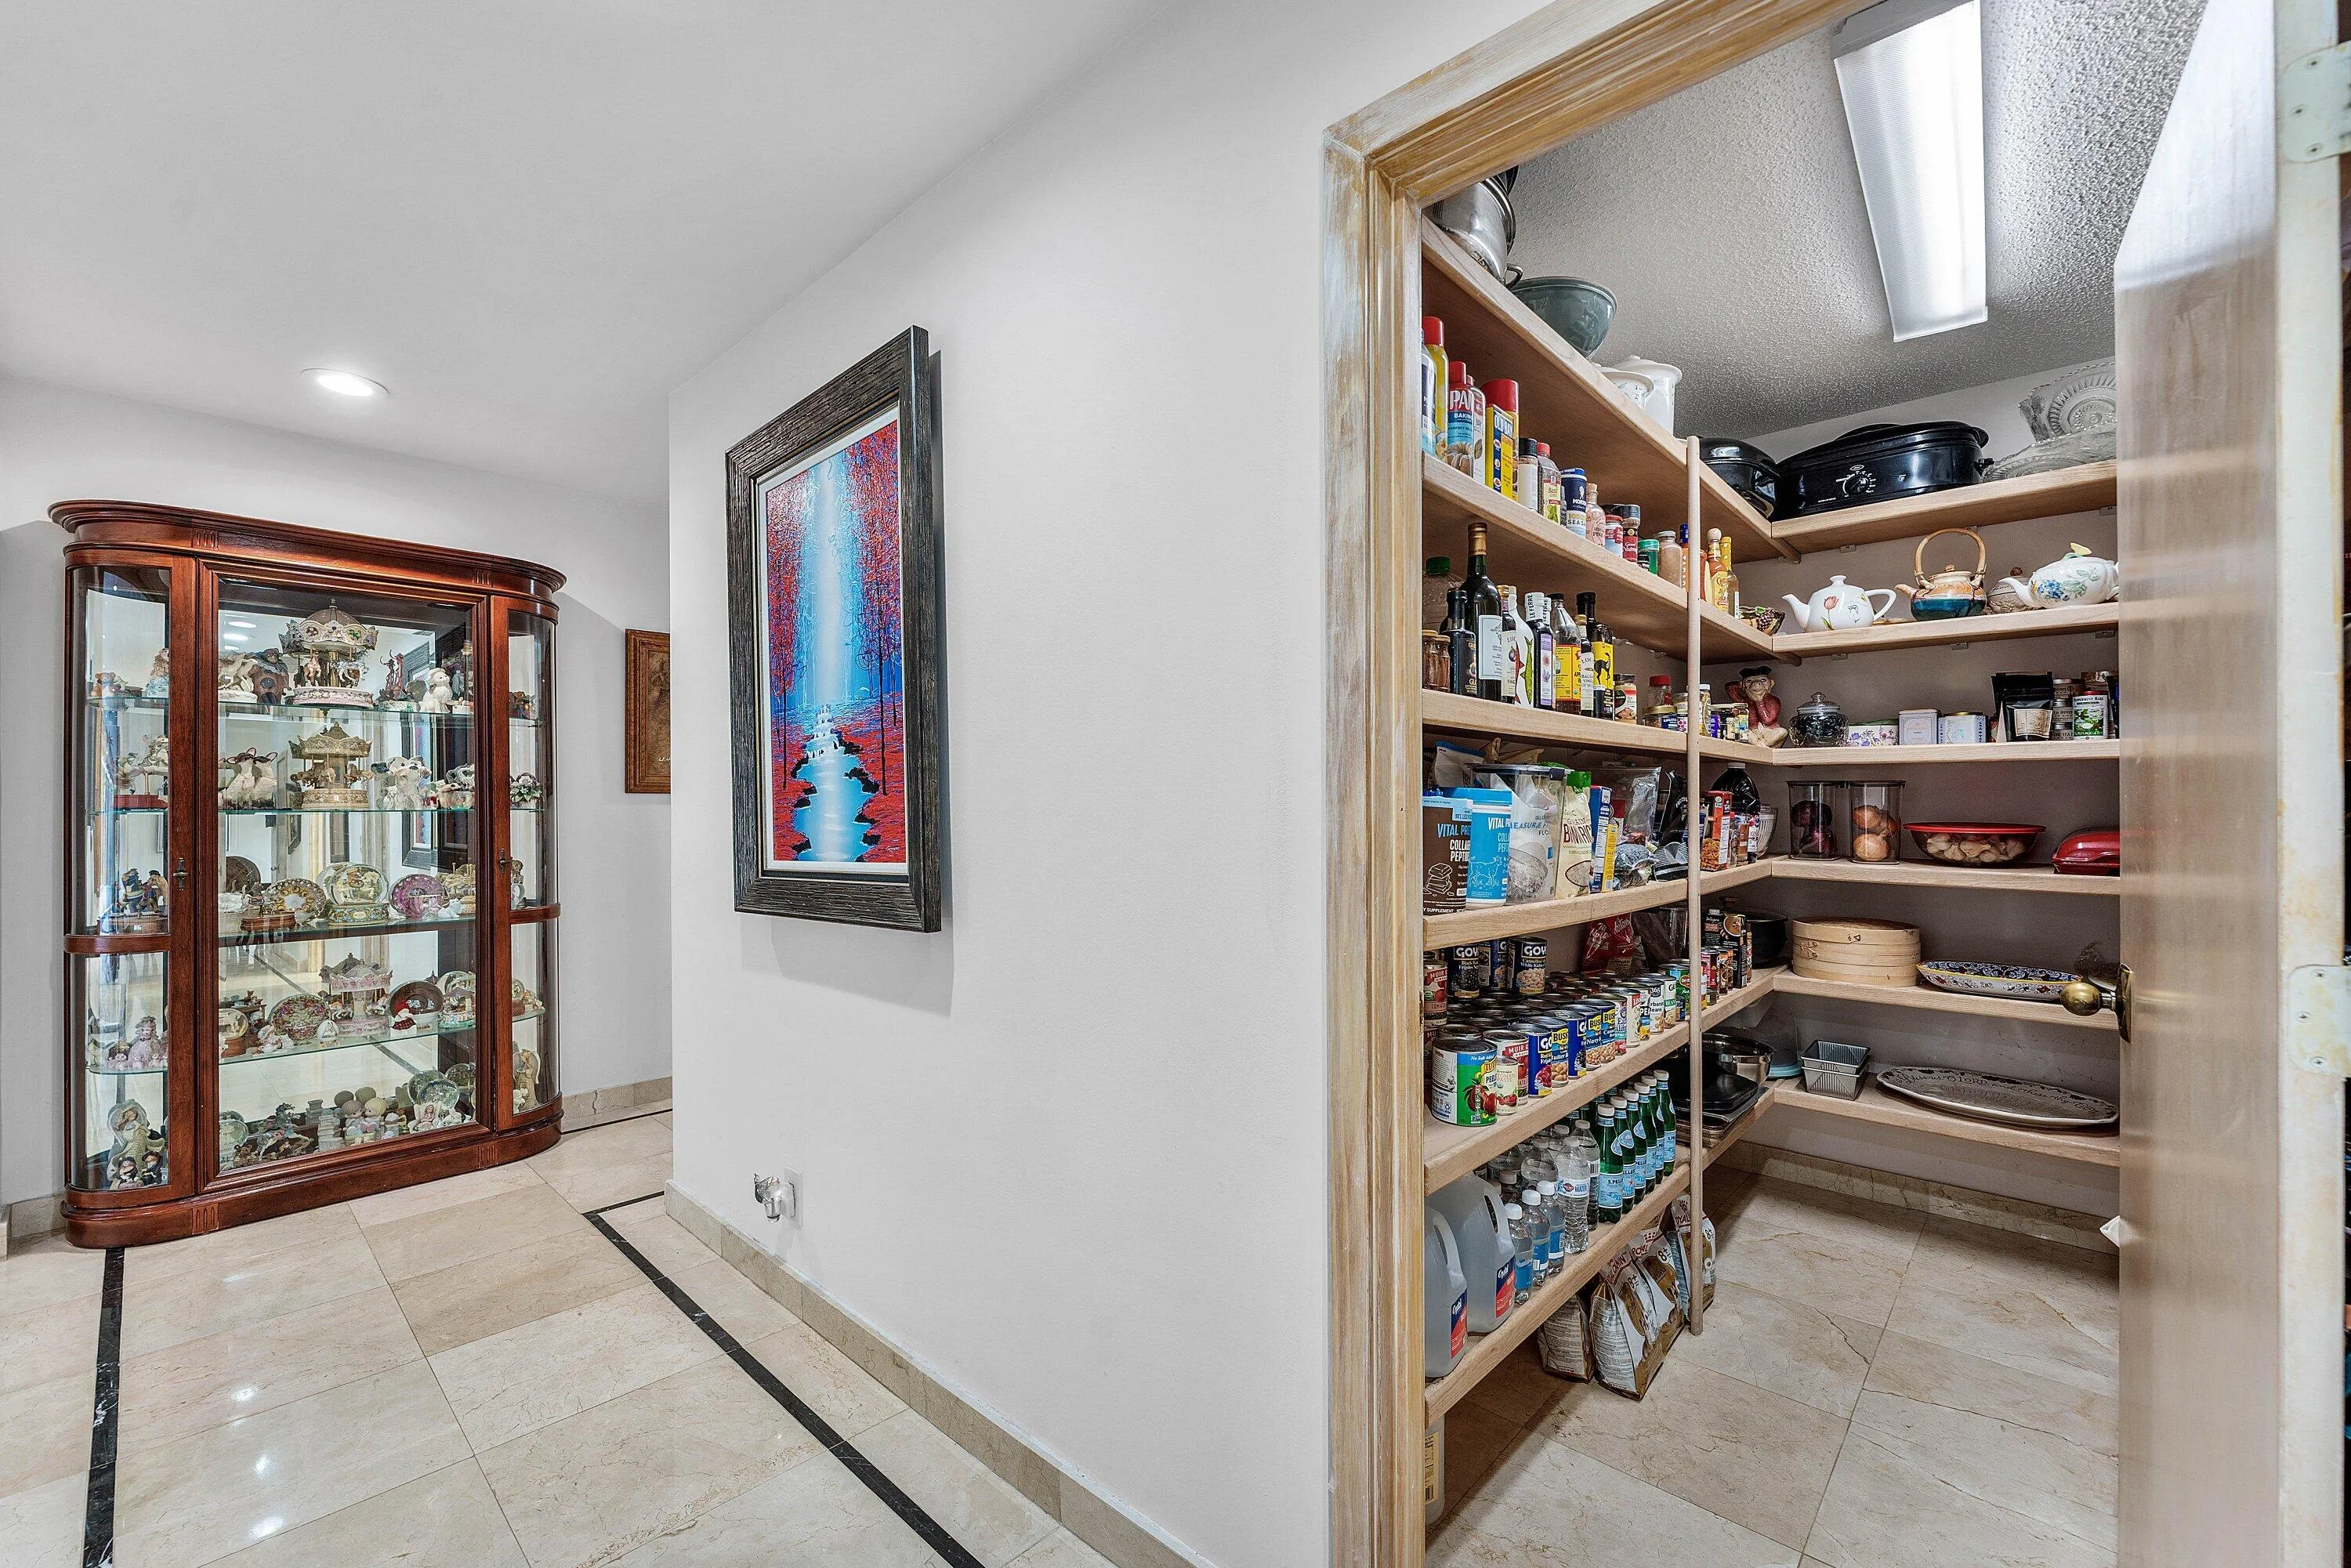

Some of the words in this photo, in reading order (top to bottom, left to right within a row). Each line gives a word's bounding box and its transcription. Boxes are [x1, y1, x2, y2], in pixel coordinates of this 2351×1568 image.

[1494, 413, 1505, 432] OLD
[1504, 418, 1512, 437] BAY
[1437, 824, 1459, 838] VITAL
[1488, 817, 1505, 831] VITAL
[1429, 970, 1444, 980] MUIR
[1587, 1036, 1598, 1048] Navy
[1509, 1045, 1523, 1056] MUIR
[1958, 1075, 1987, 1086] LORD
[1657, 1248, 1668, 1262] 8+
[1497, 1264, 1509, 1279] Crystal
[1452, 1298, 1462, 1315] Crystal
